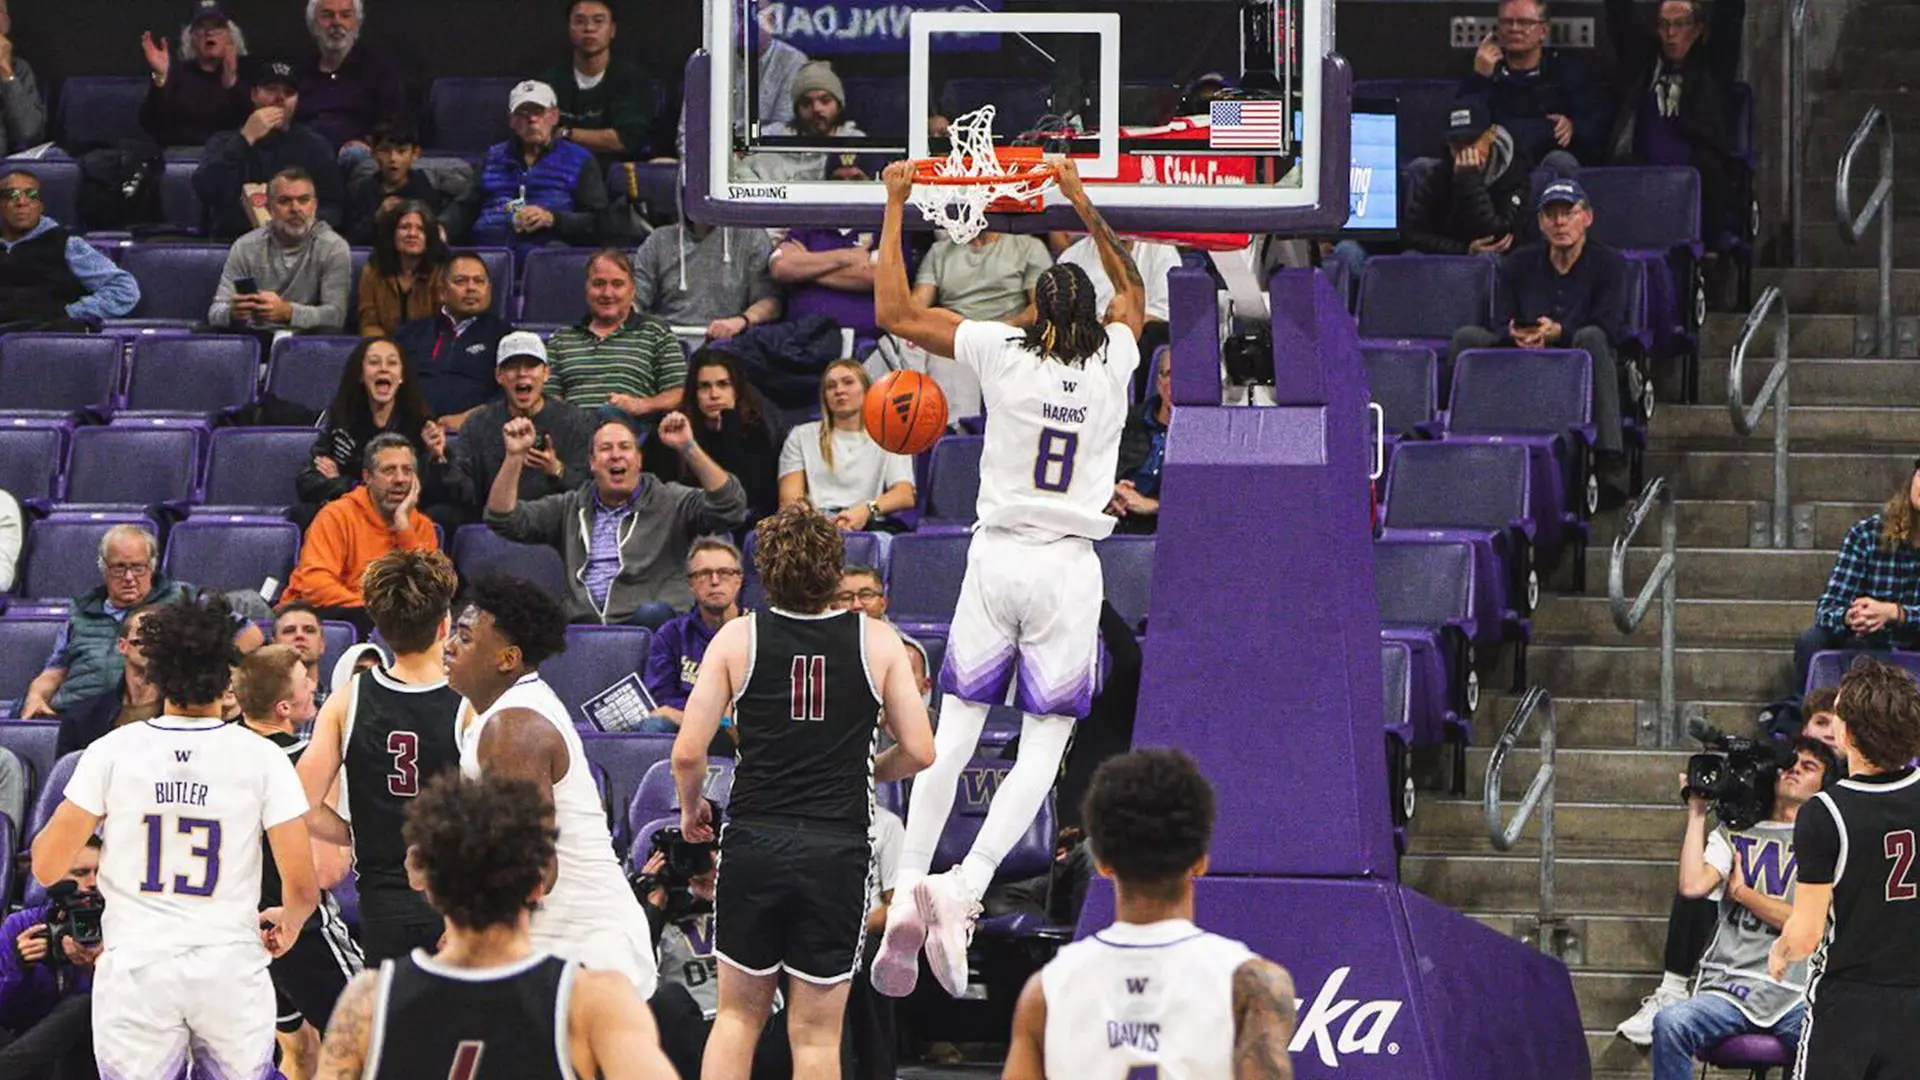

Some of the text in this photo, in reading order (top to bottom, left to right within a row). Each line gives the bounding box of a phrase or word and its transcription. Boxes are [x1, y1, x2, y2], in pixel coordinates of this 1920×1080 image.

[728, 185, 787, 199] SPALDING
[1061, 380, 1078, 393] W
[1043, 403, 1087, 423] HARRIS
[1033, 426, 1079, 494] 8
[790, 654, 826, 720] 11
[174, 750, 192, 763] W
[387, 730, 419, 797] 3
[155, 781, 209, 807] BUTLER
[139, 813, 222, 897] 13
[1884, 829, 1917, 901] 2
[1126, 977, 1149, 995] W
[1287, 966, 1403, 1067] ka
[1107, 1020, 1161, 1052] DAVIS
